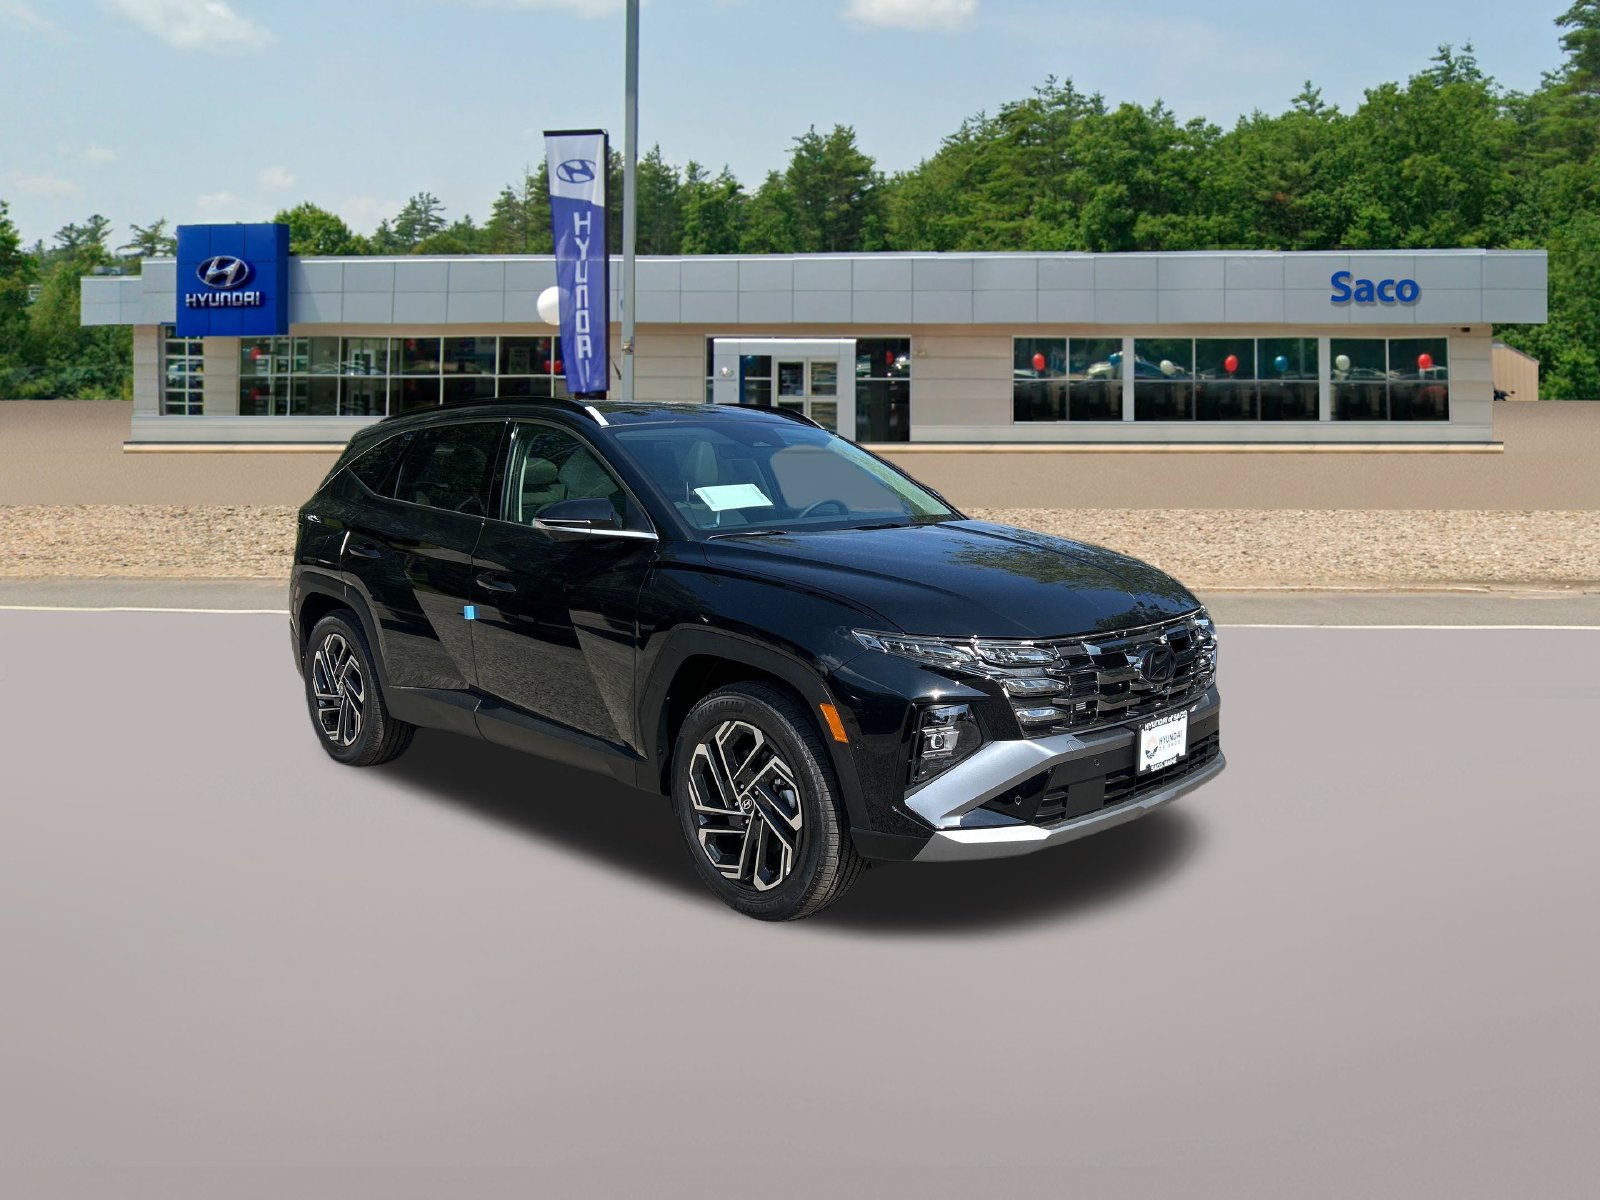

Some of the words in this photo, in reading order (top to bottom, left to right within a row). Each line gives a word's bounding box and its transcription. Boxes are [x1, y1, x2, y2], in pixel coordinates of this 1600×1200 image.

[1331, 270, 1419, 303] Saco
[185, 291, 261, 307] HYUNDAI
[573, 211, 593, 384] HYUNDAI
[1144, 716, 1168, 730] HYUNDAI
[1159, 730, 1182, 745] HYUNDAI
